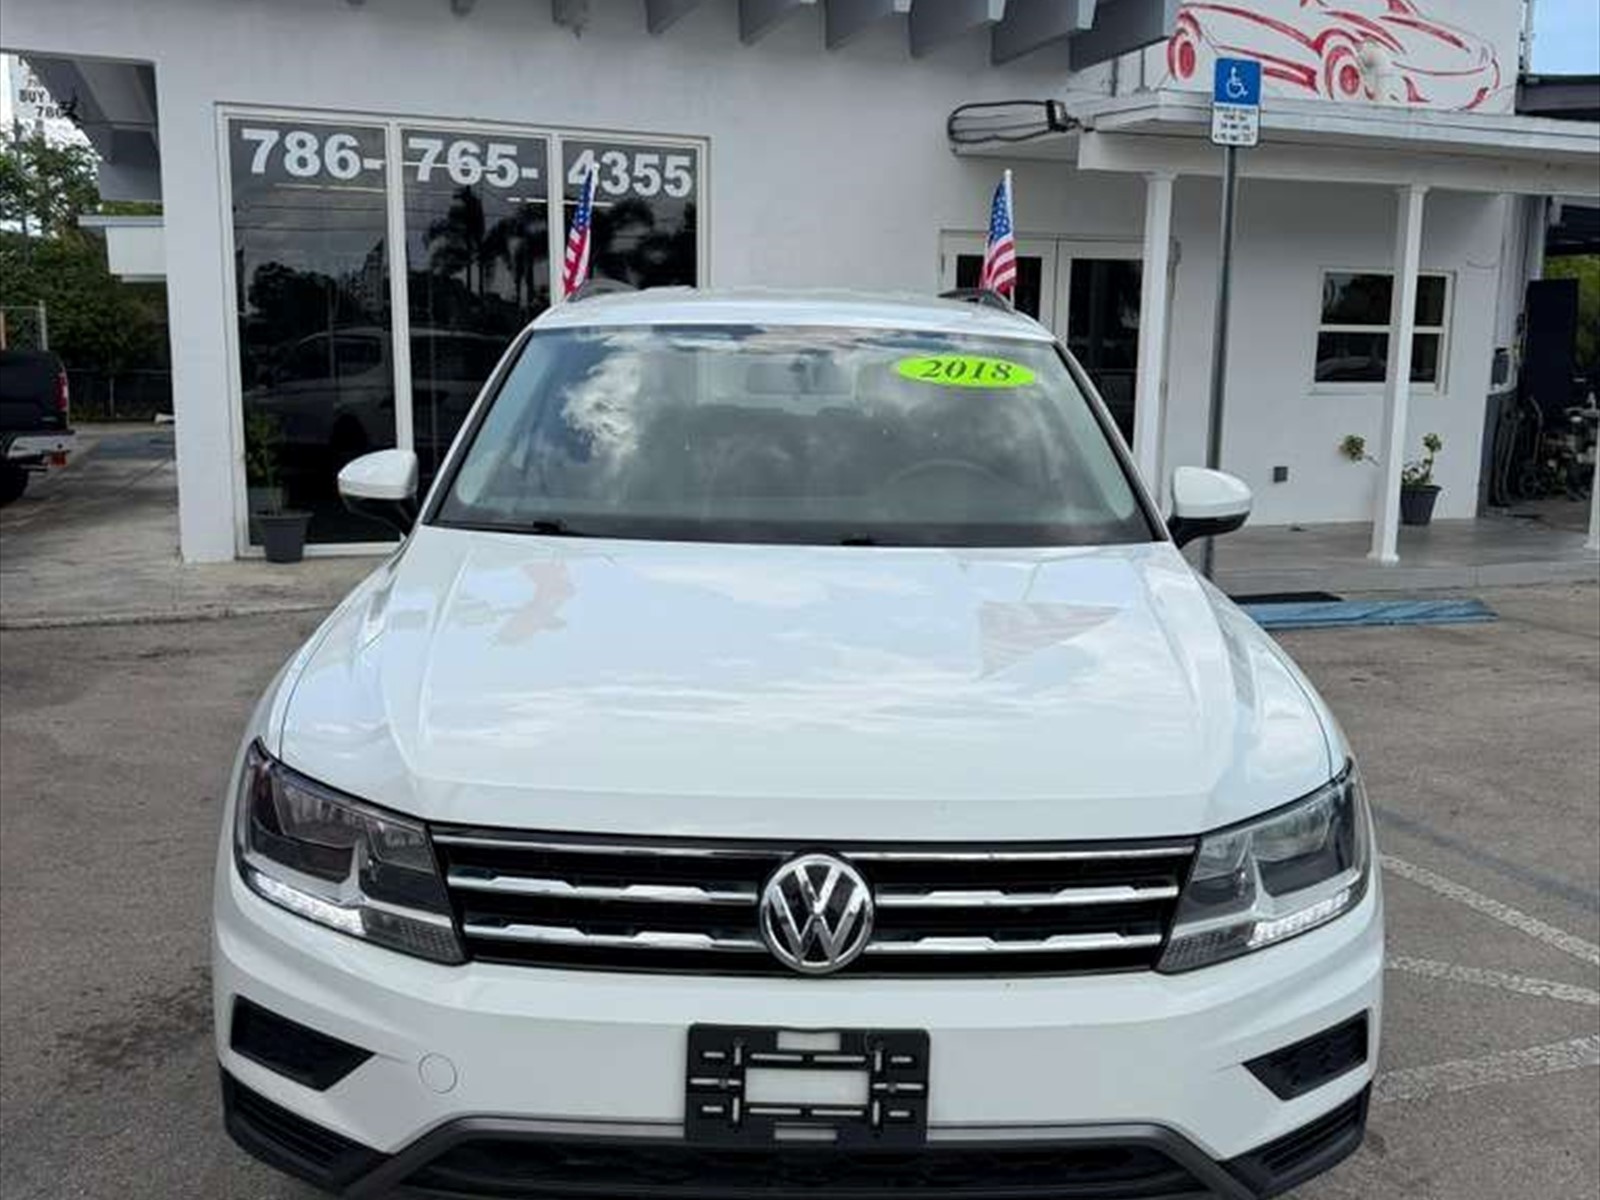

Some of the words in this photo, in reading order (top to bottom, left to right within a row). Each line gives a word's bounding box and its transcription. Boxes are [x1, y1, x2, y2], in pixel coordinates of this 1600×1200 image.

[241, 128, 384, 180] 786-
[408, 137, 539, 189] 765-
[567, 149, 692, 198] 4355
[920, 359, 1012, 381] 2018
